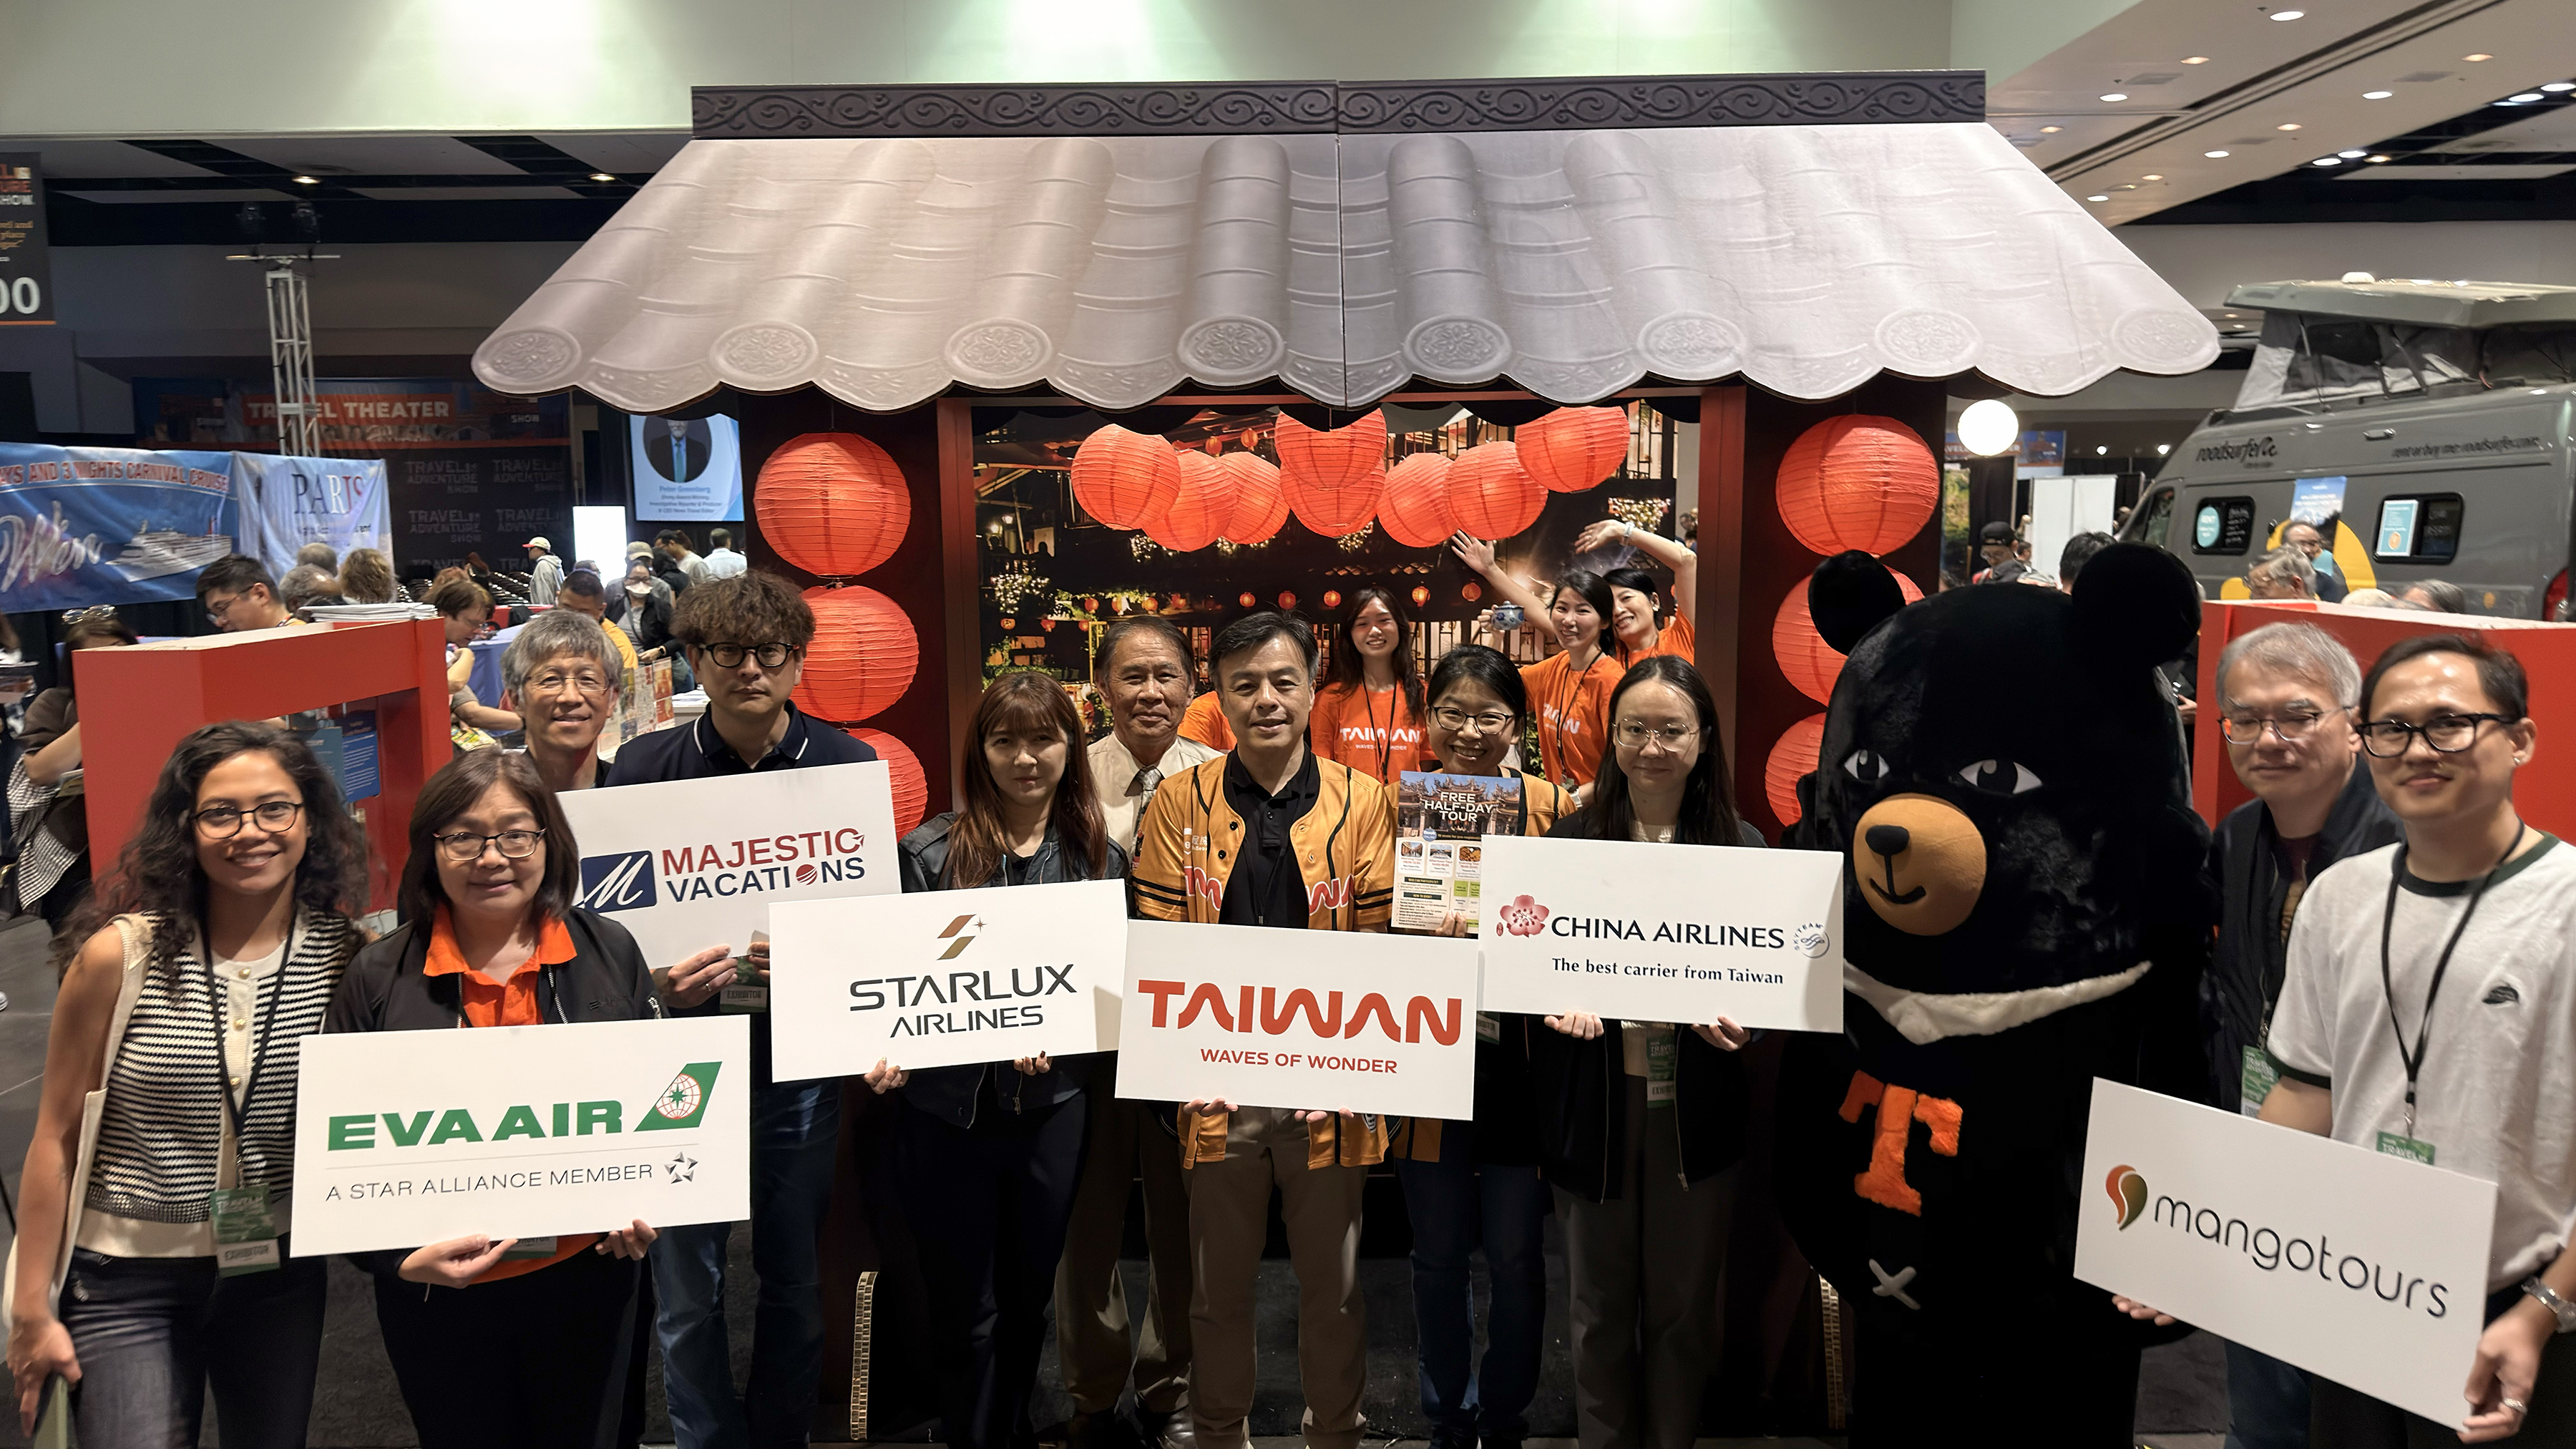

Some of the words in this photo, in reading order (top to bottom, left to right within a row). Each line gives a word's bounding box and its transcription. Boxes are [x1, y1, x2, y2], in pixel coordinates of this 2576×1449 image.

[248, 401, 337, 419] TREL
[343, 401, 450, 419] THEATER
[29, 462, 58, 482] AND
[62, 462, 72, 479] 3
[74, 461, 122, 479] GHTS
[189, 468, 230, 492] CRUISE
[405, 460, 465, 473] TRAVEL
[406, 473, 478, 484] ADVENTURE
[291, 474, 364, 514] PARIS
[409, 509, 469, 522] TRAVEL
[409, 523, 481, 535] ADVENTURE
[1340, 727, 1420, 743] TAIWAN
[1425, 800, 1493, 814] HALF-DAY
[1440, 791, 1475, 803] FREE
[1439, 810, 1478, 822] TOUR
[662, 827, 864, 876] MAJESTIC
[666, 857, 865, 902] VACATIONS
[1551, 916, 1645, 942] CHINA
[1653, 921, 1785, 949] AIRLINES
[1553, 957, 1579, 972] The
[1586, 960, 1617, 975] best
[1624, 964, 1678, 978] carrier
[1684, 965, 1722, 981] from
[1727, 968, 1783, 985] Taiwan
[727, 990, 761, 999] EXHIBITOR
[850, 964, 1077, 1011] STARLUX
[890, 1005, 1043, 1038] AIRLINES
[1138, 980, 1462, 1046] TAIWAN
[1201, 1049, 1269, 1065] WAVES
[1275, 1053, 1302, 1068] OF
[1308, 1055, 1397, 1073] WONDER
[328, 1108, 484, 1151] EVA
[492, 1100, 623, 1141] AIR
[1839, 1070, 1963, 1216] T
[326, 1186, 341, 1201] A
[350, 1181, 411, 1200] STAR
[422, 1172, 542, 1195] ALLIANCE
[550, 1164, 653, 1186] MEMBER
[2155, 1196, 2449, 1317] mangotours
